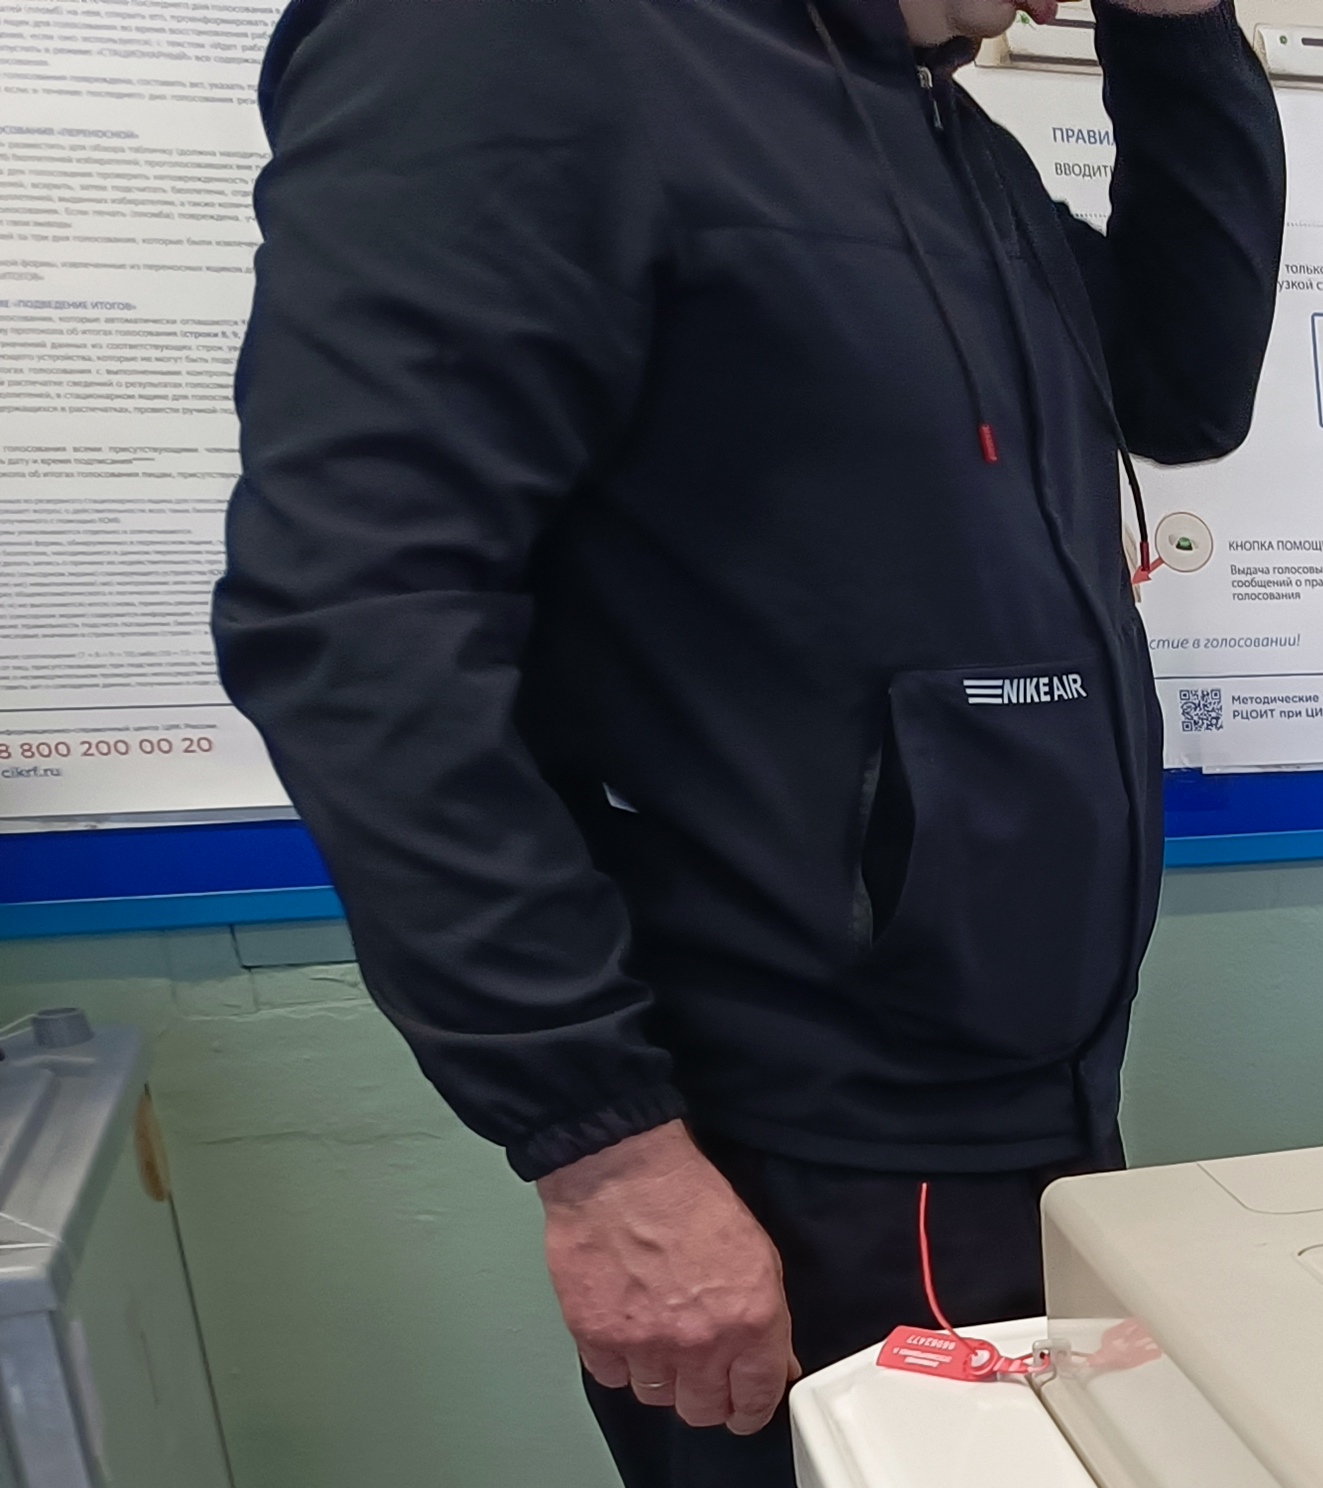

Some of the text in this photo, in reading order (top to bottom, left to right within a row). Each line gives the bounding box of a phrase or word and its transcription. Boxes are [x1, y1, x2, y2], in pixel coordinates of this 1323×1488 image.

[1052, 127, 1113, 146] ПРАВИ
[1278, 279, 1313, 292] узкой
[1228, 540, 1273, 552] КНОПКА
[1231, 564, 1269, 577] Выдача
[1231, 577, 1292, 590] сообщений
[1295, 579, 1301, 587] о
[1232, 591, 1301, 600] голосования
[1193, 638, 1200, 649] в
[1204, 633, 1300, 649] голосовании!
[1003, 674, 1087, 704] NIKE AIR
[1231, 693, 1318, 705] Методические
[1233, 709, 1274, 721] РЦОИТ
[1279, 709, 1301, 720] при
[20, 741, 71, 759] 800
[80, 739, 129, 757] 200
[139, 738, 173, 755] 00
[181, 736, 213, 753] 20
[1, 766, 61, 778] cikrf.ru
